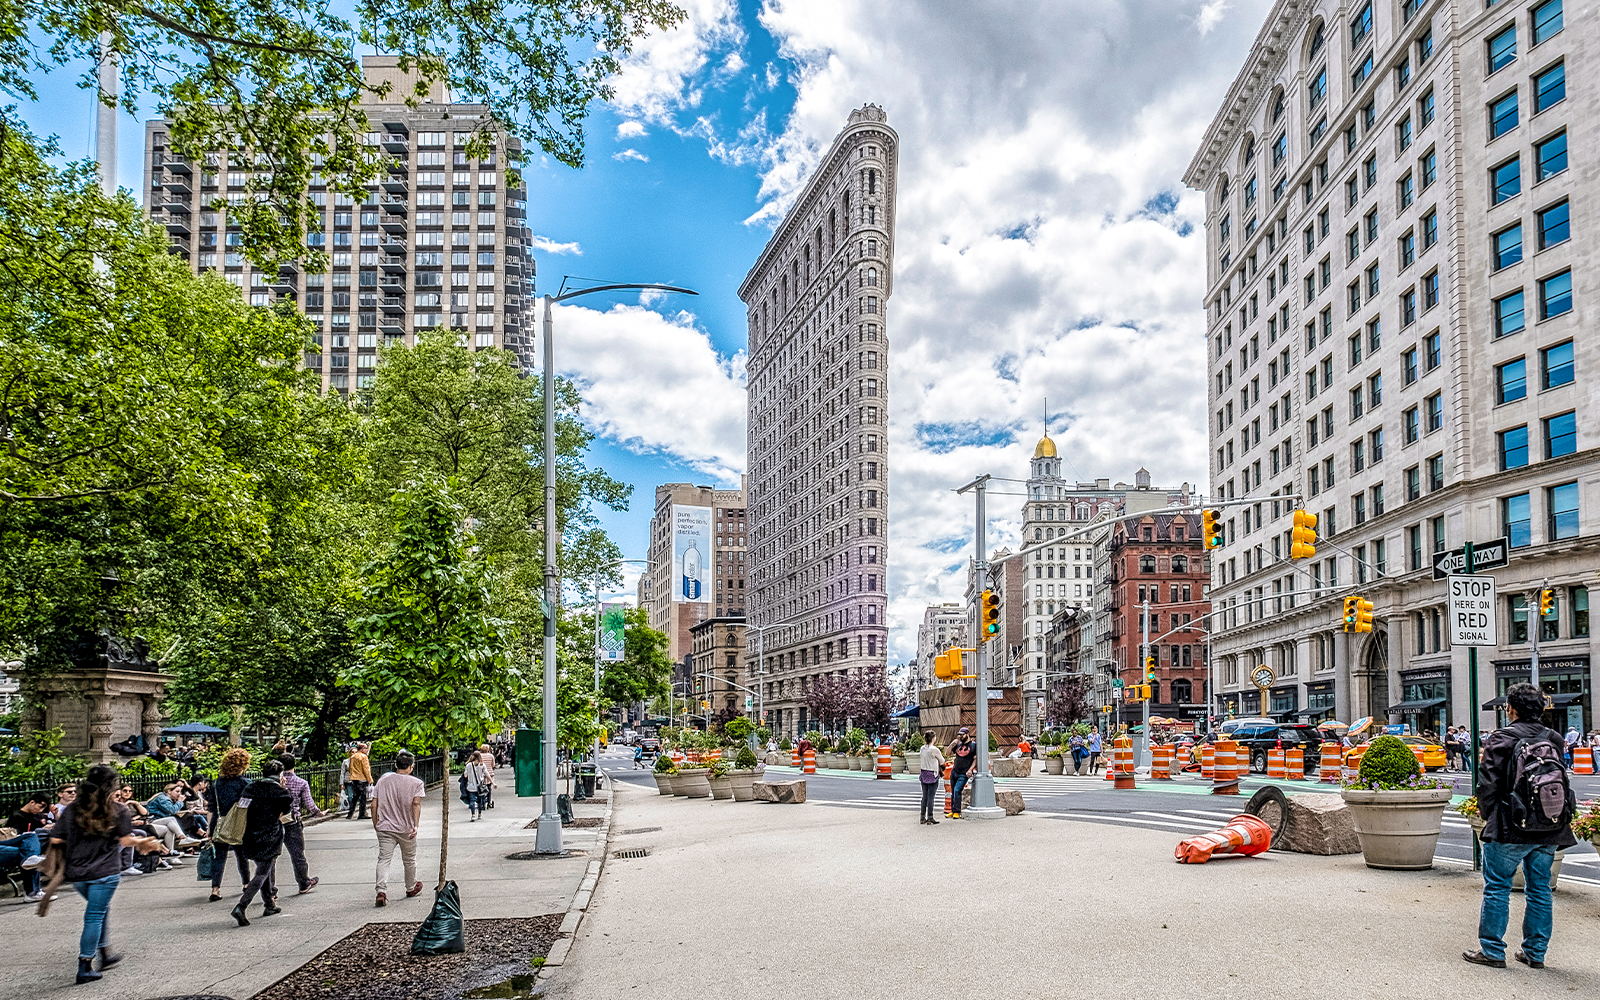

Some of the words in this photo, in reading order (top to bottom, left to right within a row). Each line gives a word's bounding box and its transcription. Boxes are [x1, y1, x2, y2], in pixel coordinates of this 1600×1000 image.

[1443, 556, 1464, 570] ONE
[1473, 548, 1497, 563] WAY
[1452, 580, 1491, 597] STOP
[1454, 600, 1476, 609] HERE
[1478, 600, 1490, 609] ON
[1457, 612, 1488, 628] RED
[1459, 631, 1488, 641] SIGNAL
